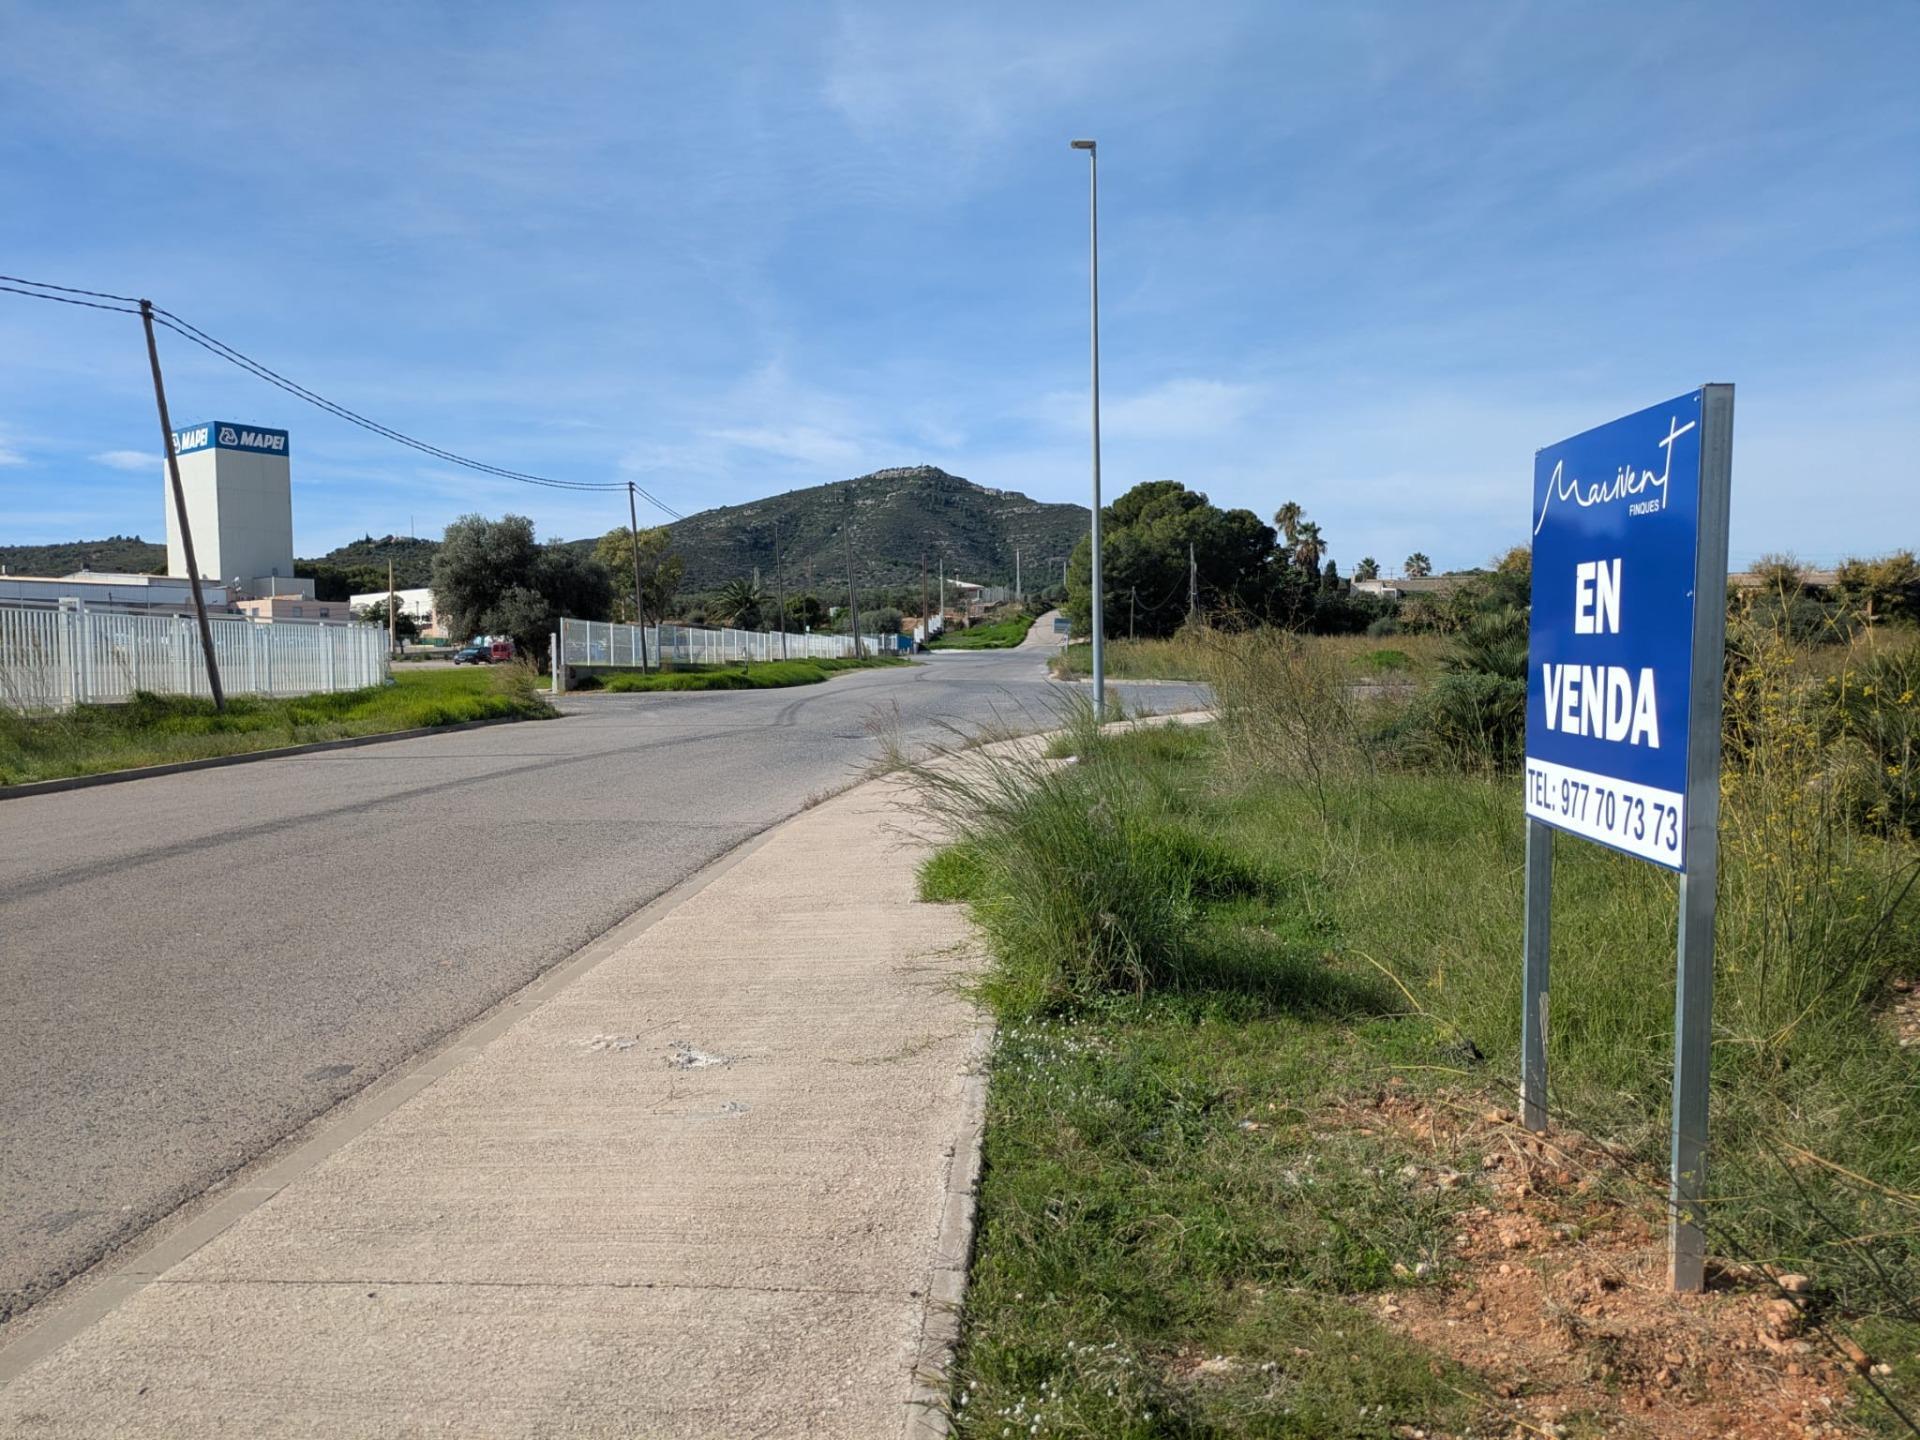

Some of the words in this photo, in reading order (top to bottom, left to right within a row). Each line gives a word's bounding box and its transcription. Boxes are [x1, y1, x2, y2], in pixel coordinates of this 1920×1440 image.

[181, 428, 209, 451] MAPEI
[240, 431, 285, 450] MAPEI
[1535, 416, 1695, 535] Marivent
[1629, 499, 1660, 516] FINQUES
[1575, 558, 1622, 634] EN
[1543, 663, 1660, 749] VENDA
[1528, 768, 1556, 811] TEL:
[1562, 778, 1590, 821] 977
[1595, 787, 1616, 831] 70
[1623, 794, 1645, 840] 73
[1653, 802, 1678, 851] 73
